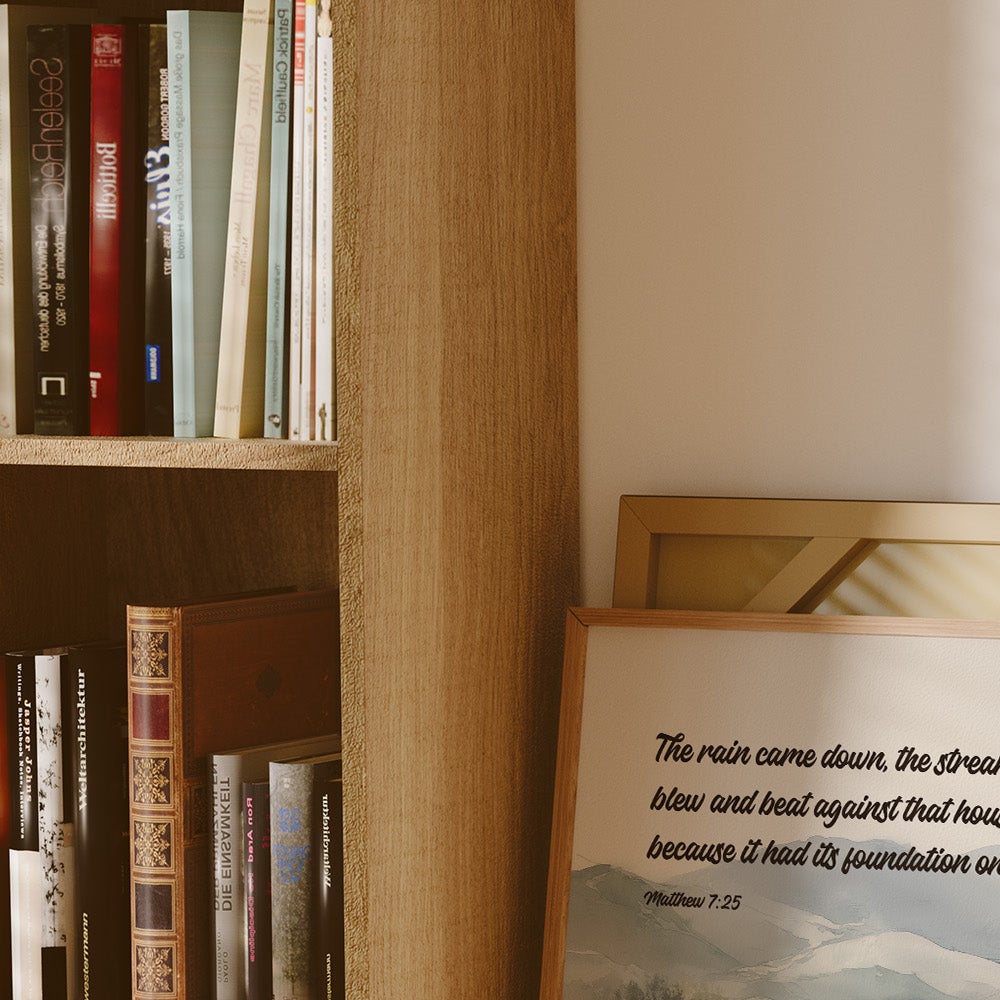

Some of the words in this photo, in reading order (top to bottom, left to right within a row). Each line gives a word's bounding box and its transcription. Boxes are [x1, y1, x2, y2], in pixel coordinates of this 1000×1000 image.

[23, 699, 32, 751] Jasper
[77, 668, 88, 811] Weltarchitektur
[655, 732, 695, 763] The
[697, 740, 751, 765] rain
[755, 745, 817, 768] came
[821, 744, 888, 773] down,
[894, 746, 933, 773] the
[24, 757, 33, 803] Johns
[650, 786, 705, 813] blew
[710, 790, 759, 815] and
[759, 790, 813, 818] beat
[813, 795, 904, 828] against
[902, 796, 955, 823] that
[646, 834, 736, 865] because
[740, 838, 763, 863] it
[761, 839, 812, 867] had
[812, 842, 840, 870] its
[841, 845, 971, 875] foundation
[644, 890, 706, 910] Matthew
[707, 894, 742, 911] 7:25
